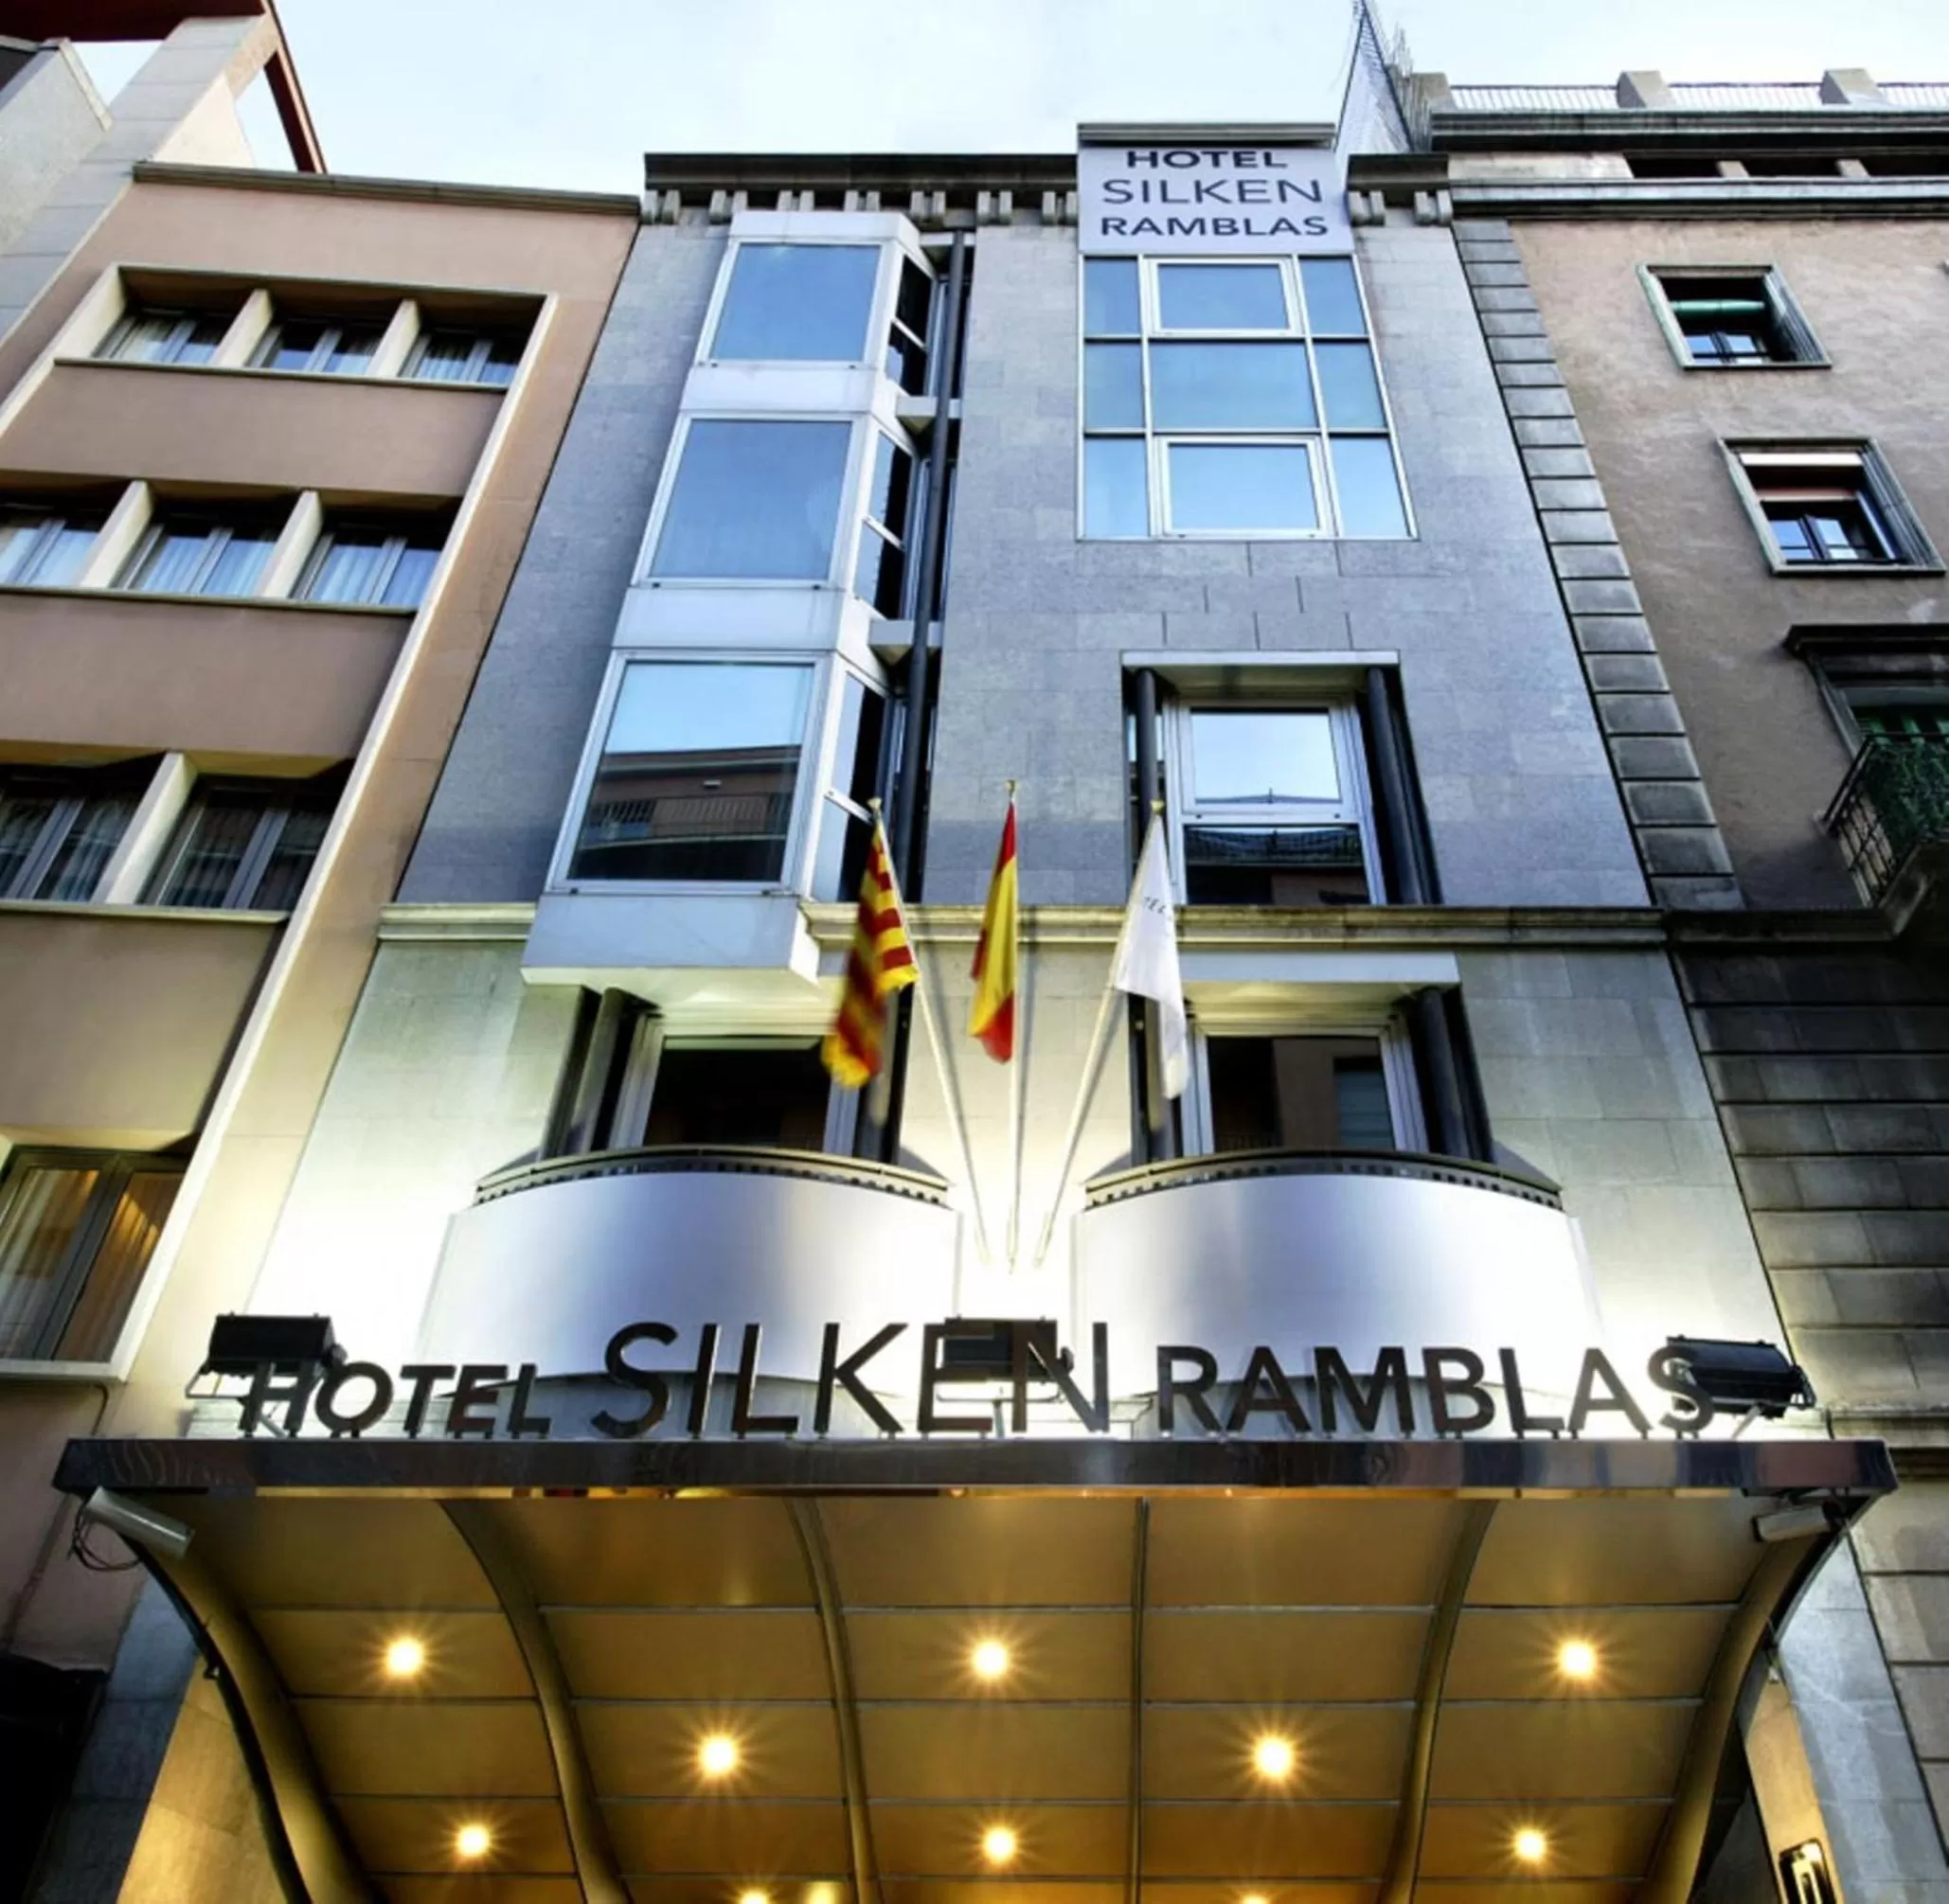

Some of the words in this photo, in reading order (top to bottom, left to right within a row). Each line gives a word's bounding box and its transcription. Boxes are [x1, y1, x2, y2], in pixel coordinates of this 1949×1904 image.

[1126, 150, 1288, 169] HOTEL
[1101, 179, 1323, 205] SILKEN
[1100, 216, 1329, 237] RAMBLAS
[238, 1361, 552, 1434] HOTEL
[590, 1321, 1109, 1440] SILKEN
[1156, 1344, 1714, 1433] RAMBLAS
